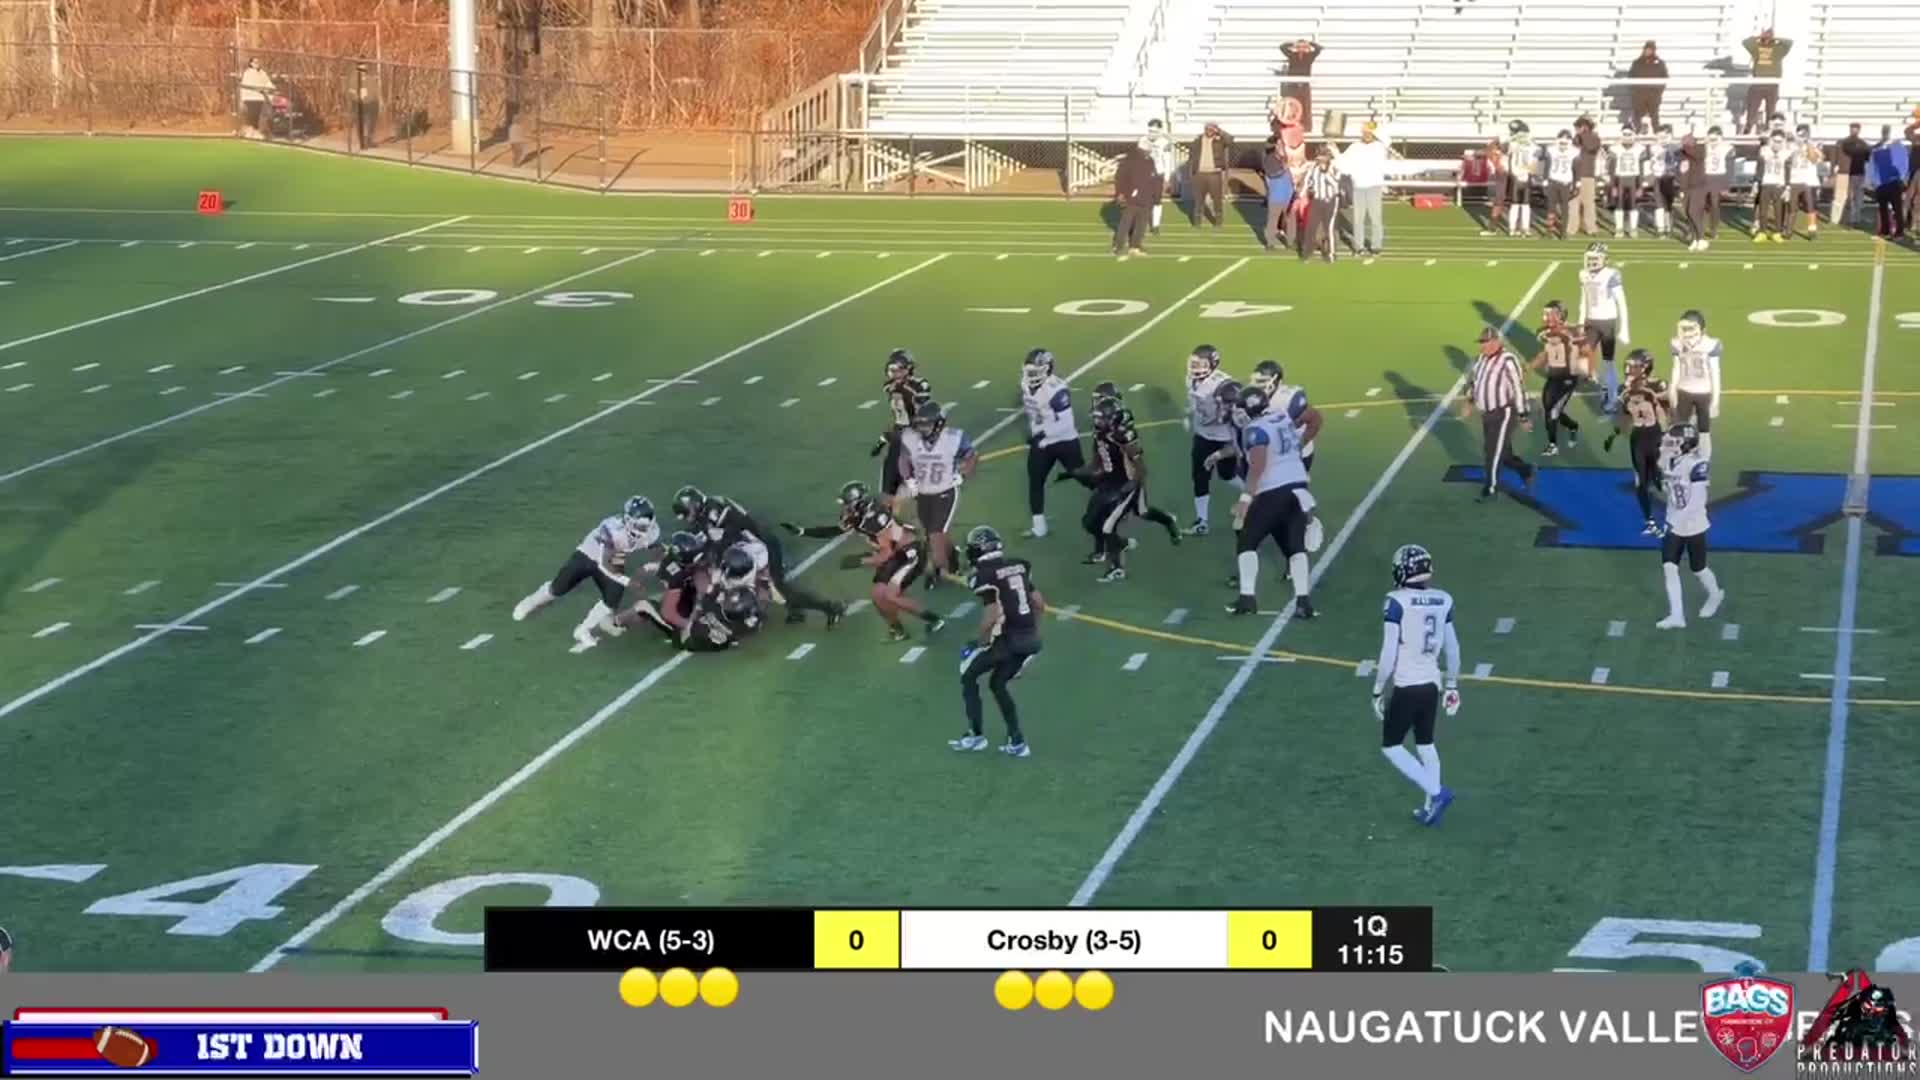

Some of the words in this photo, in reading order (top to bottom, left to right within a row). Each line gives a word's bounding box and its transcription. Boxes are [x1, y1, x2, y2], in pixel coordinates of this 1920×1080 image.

[199, 194, 217, 209] 20
[731, 203, 748, 217] 30
[1422, 615, 1437, 655] 2
